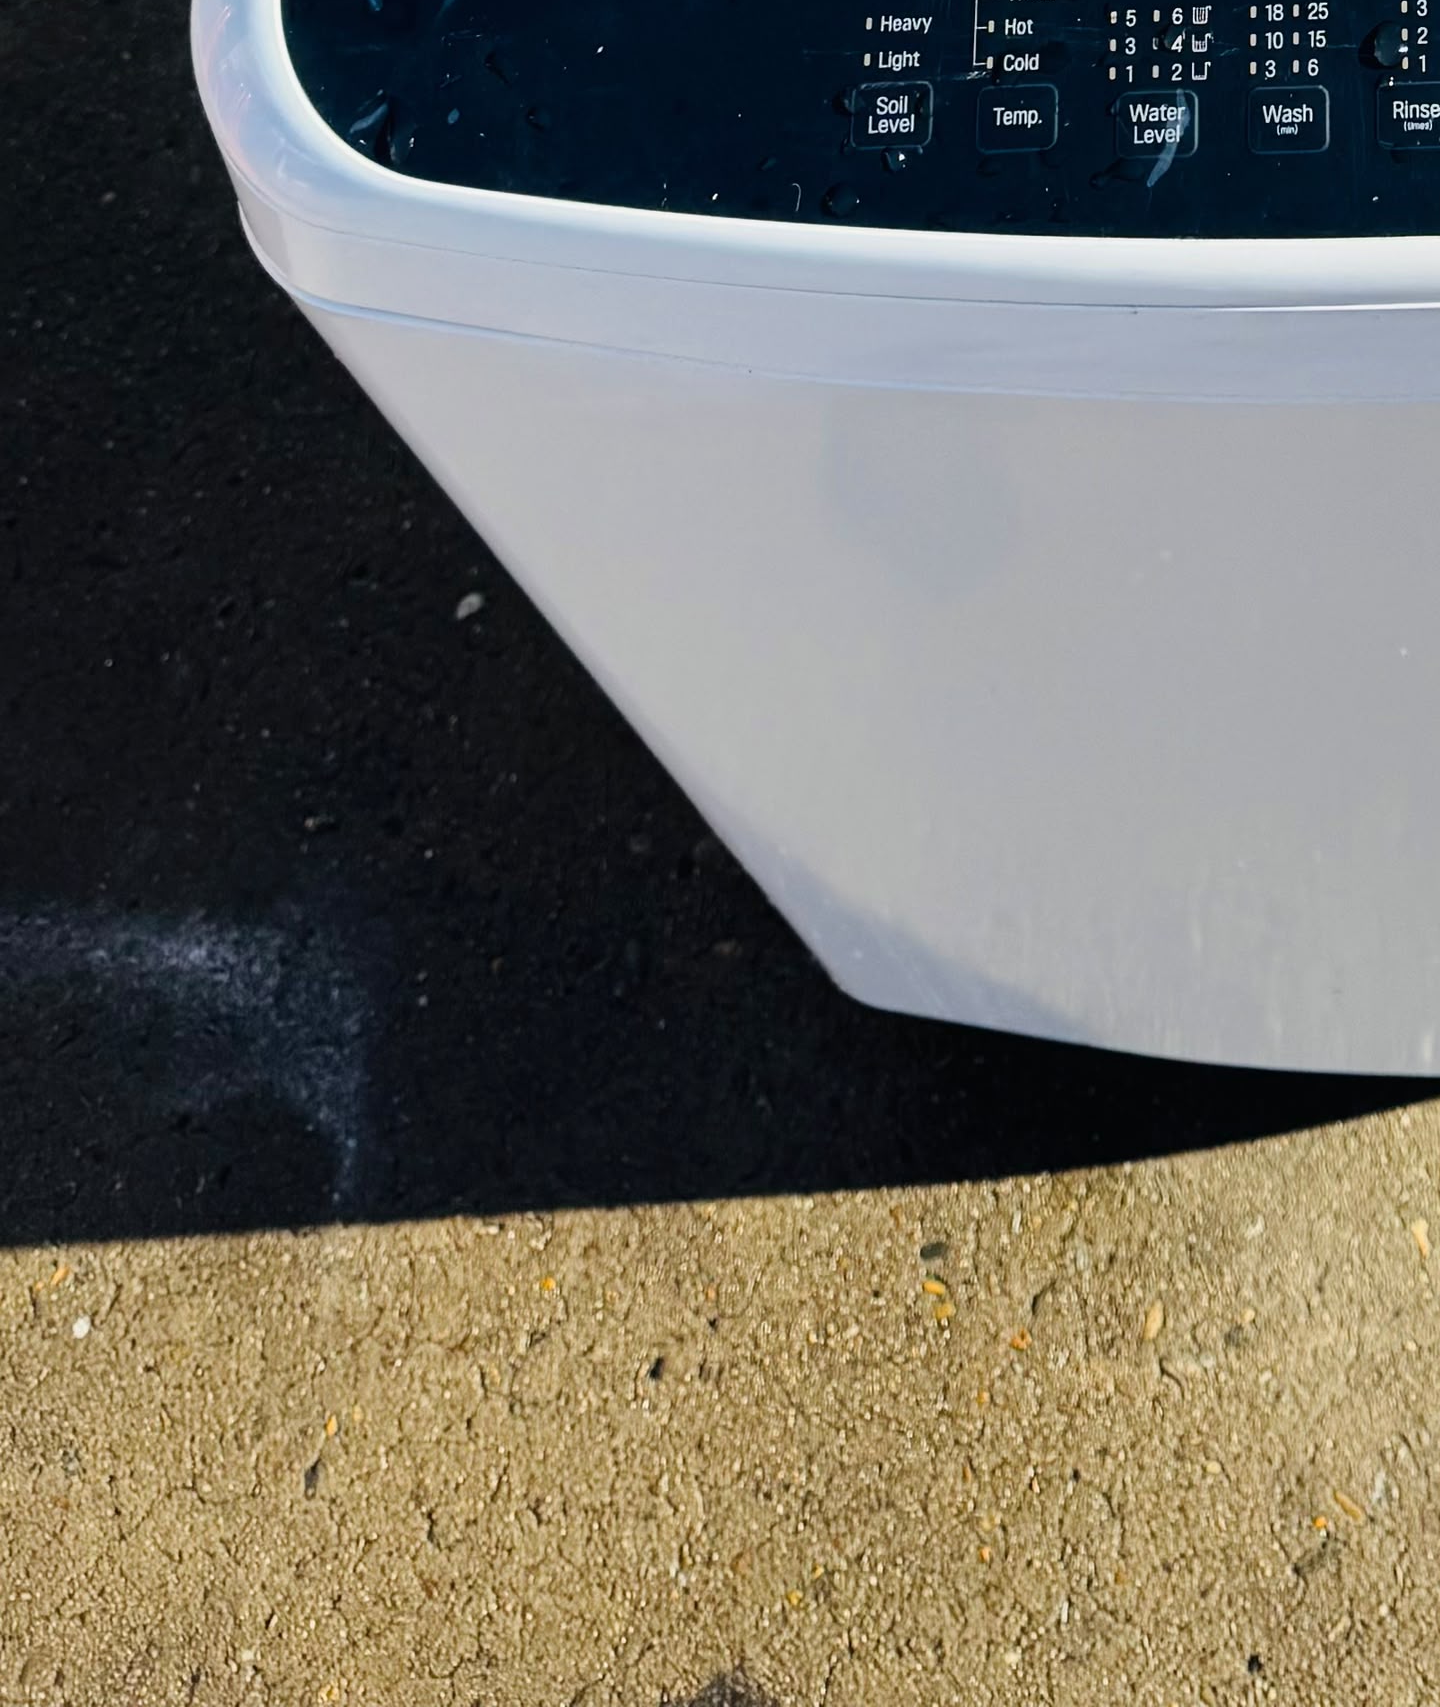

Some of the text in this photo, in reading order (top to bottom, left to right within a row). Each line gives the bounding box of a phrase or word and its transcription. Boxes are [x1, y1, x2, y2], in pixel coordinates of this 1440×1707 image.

[1171, 7, 1184, 25] 6
[1264, 3, 1284, 21] 18
[1307, 2, 1329, 20] 25
[1416, 0, 1429, 17] 3
[879, 15, 932, 35] Heavy
[1125, 9, 1137, 27] 5
[1004, 19, 1034, 36] Hot
[1416, 27, 1429, 45] 2
[1125, 37, 1136, 55] 3
[1171, 35, 1184, 53] 4
[1264, 31, 1284, 50] 10
[1308, 30, 1327, 48] 15
[877, 50, 920, 71] Light
[1002, 53, 1040, 71] Cold
[1264, 60, 1276, 78] 3
[1307, 59, 1319, 77] 6
[1418, 55, 1427, 73] 1
[1125, 65, 1134, 83] 1
[1171, 63, 1183, 81] 2
[875, 96, 908, 116] Soil
[1129, 103, 1186, 123] Water
[1262, 104, 1313, 124] Wash
[1392, 99, 1440, 120] Rinse
[867, 114, 915, 135] Level
[993, 107, 1043, 127] Temp.
[1133, 125, 1181, 144] Level
[1276, 124, 1299, 136] (min)
